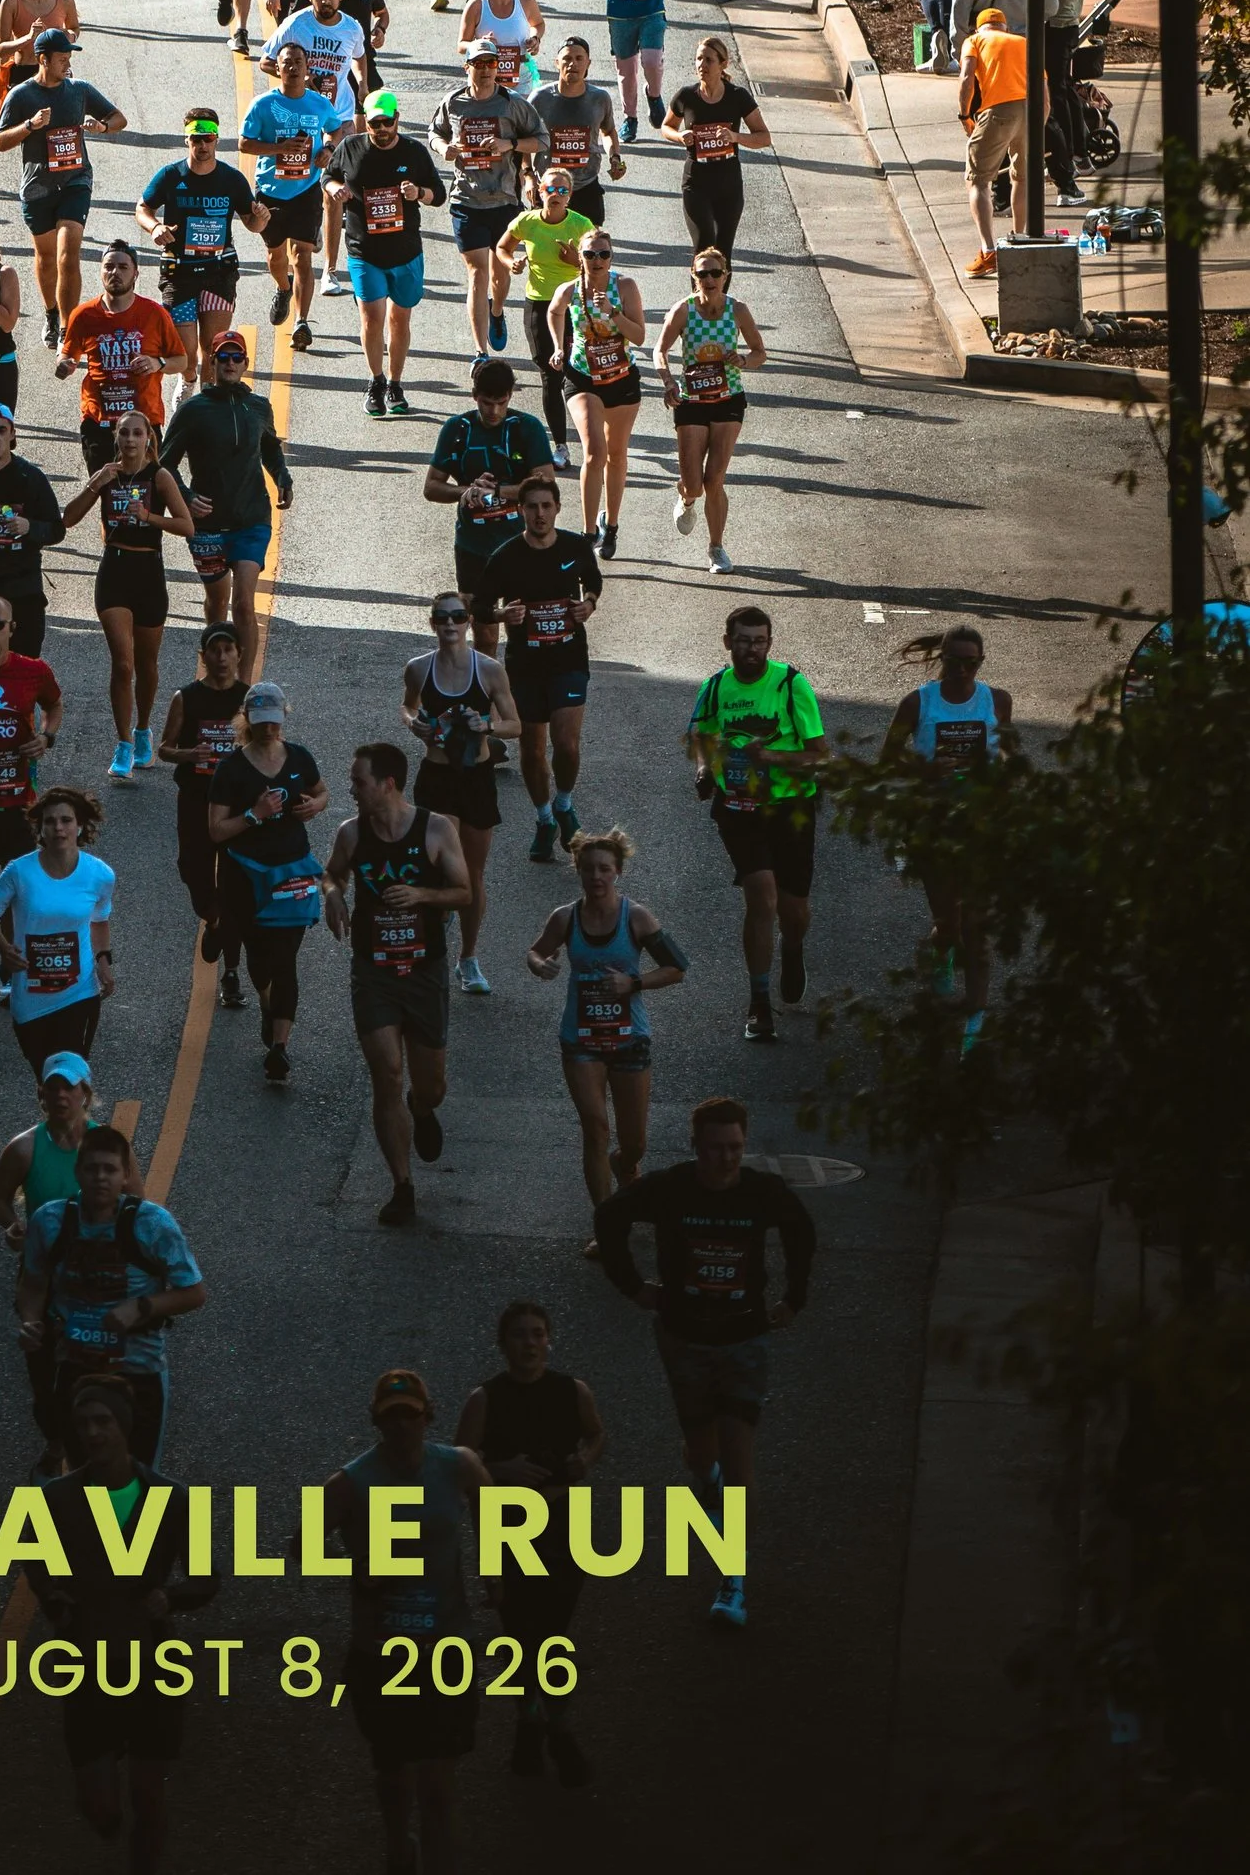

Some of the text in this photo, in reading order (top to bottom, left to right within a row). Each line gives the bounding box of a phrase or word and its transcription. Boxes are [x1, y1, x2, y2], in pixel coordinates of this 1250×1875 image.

[312, 36, 342, 53] 1907
[55, 143, 76, 152] 1808
[556, 142, 585, 150] 14805
[282, 154, 307, 162] 3208
[371, 204, 397, 214] 2338
[192, 233, 220, 242] 21917
[100, 341, 141, 356] NASH
[102, 355, 131, 367] VILL
[596, 353, 618, 365] 1616
[691, 377, 723, 390] 13639
[104, 401, 135, 411] 14126
[536, 621, 565, 631] 1592
[381, 929, 415, 940] 2638
[36, 955, 72, 967] 2065
[586, 1004, 622, 1015] 2830
[698, 1265, 736, 1278] 4158
[71, 1327, 118, 1344] 20815
